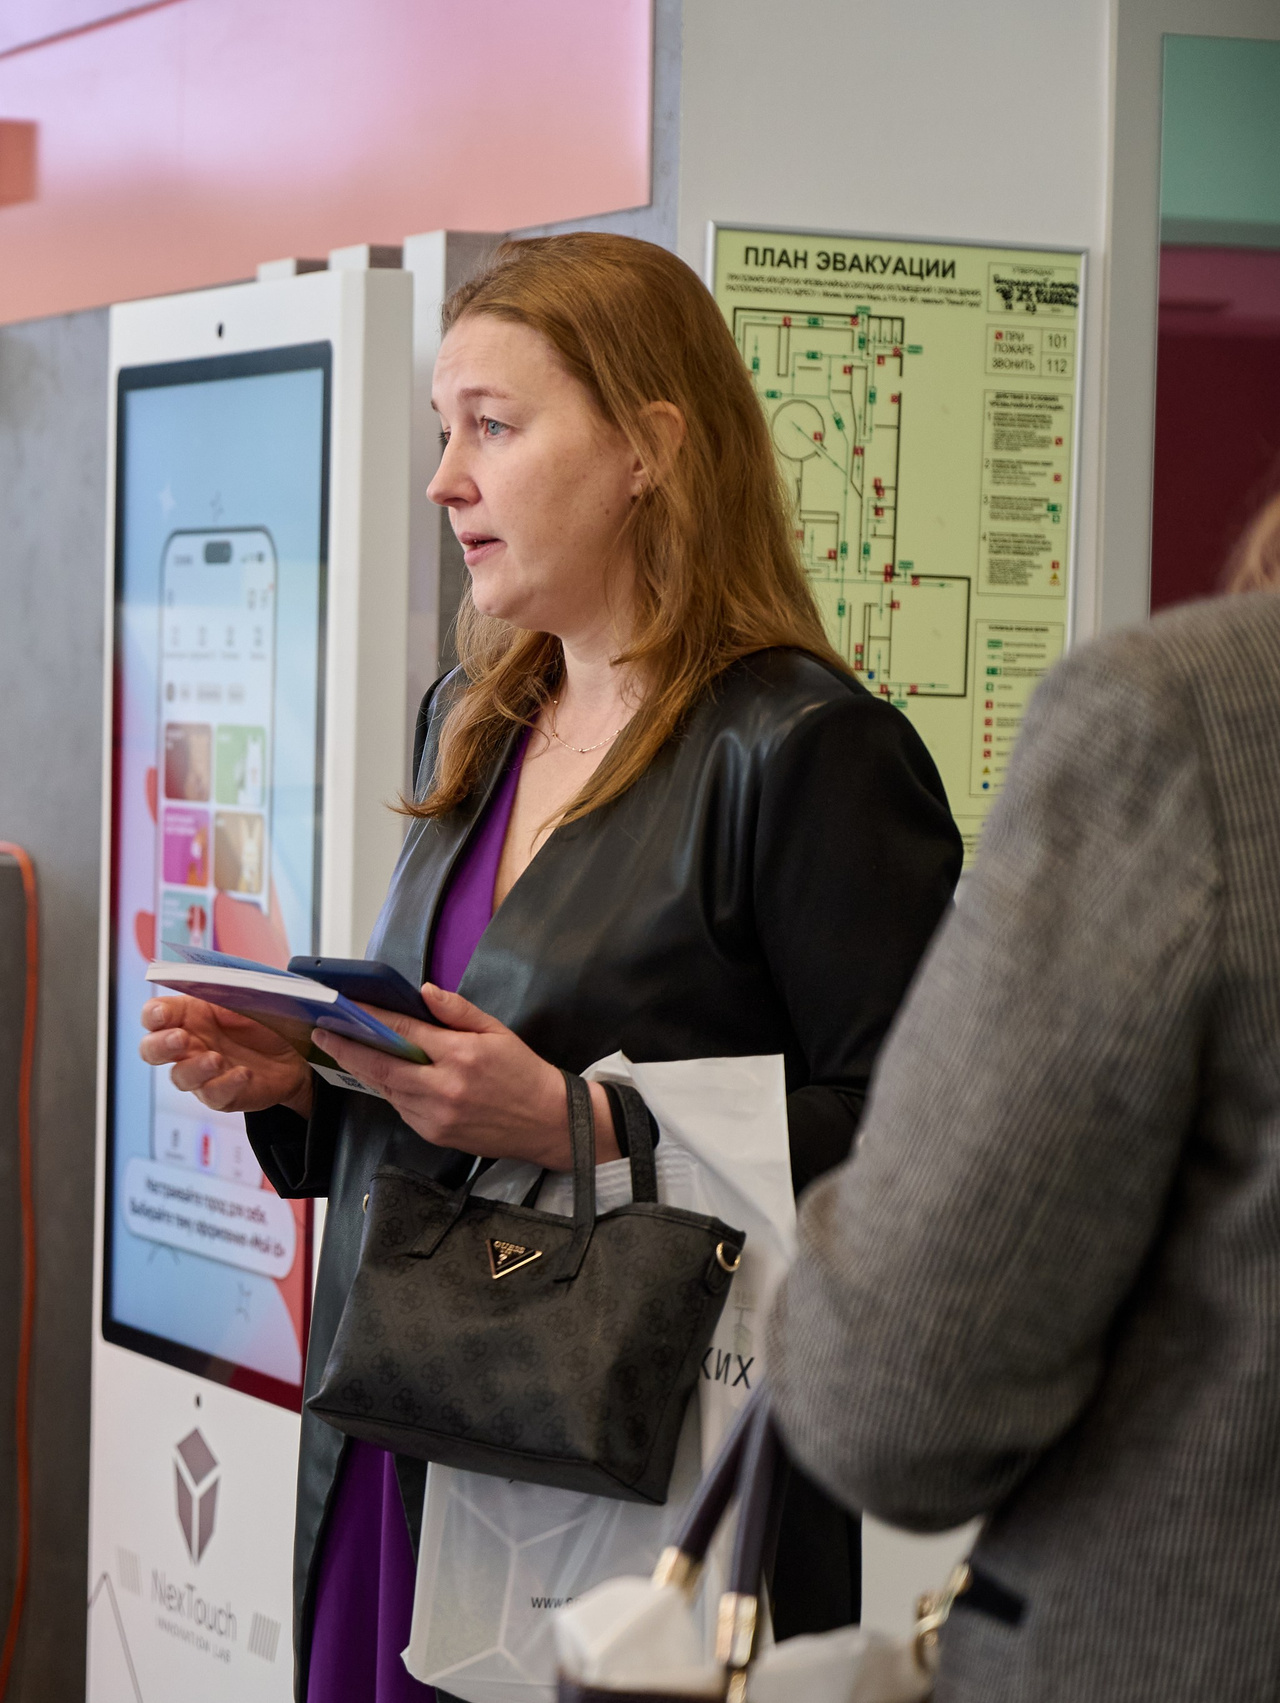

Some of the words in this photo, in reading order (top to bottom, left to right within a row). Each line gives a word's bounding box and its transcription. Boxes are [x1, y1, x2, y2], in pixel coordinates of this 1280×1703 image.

[744, 247, 808, 270] ПЛАН
[816, 251, 956, 280] ЭВАКУАЦИИ
[1004, 331, 1025, 343] ПРИ
[1048, 333, 1068, 349] 101
[994, 342, 1034, 355] ПОЖАРЕ
[992, 357, 1036, 372] ЗВОНИТЬ
[1047, 358, 1068, 374] 112
[151, 1569, 238, 1641] NexTouch
